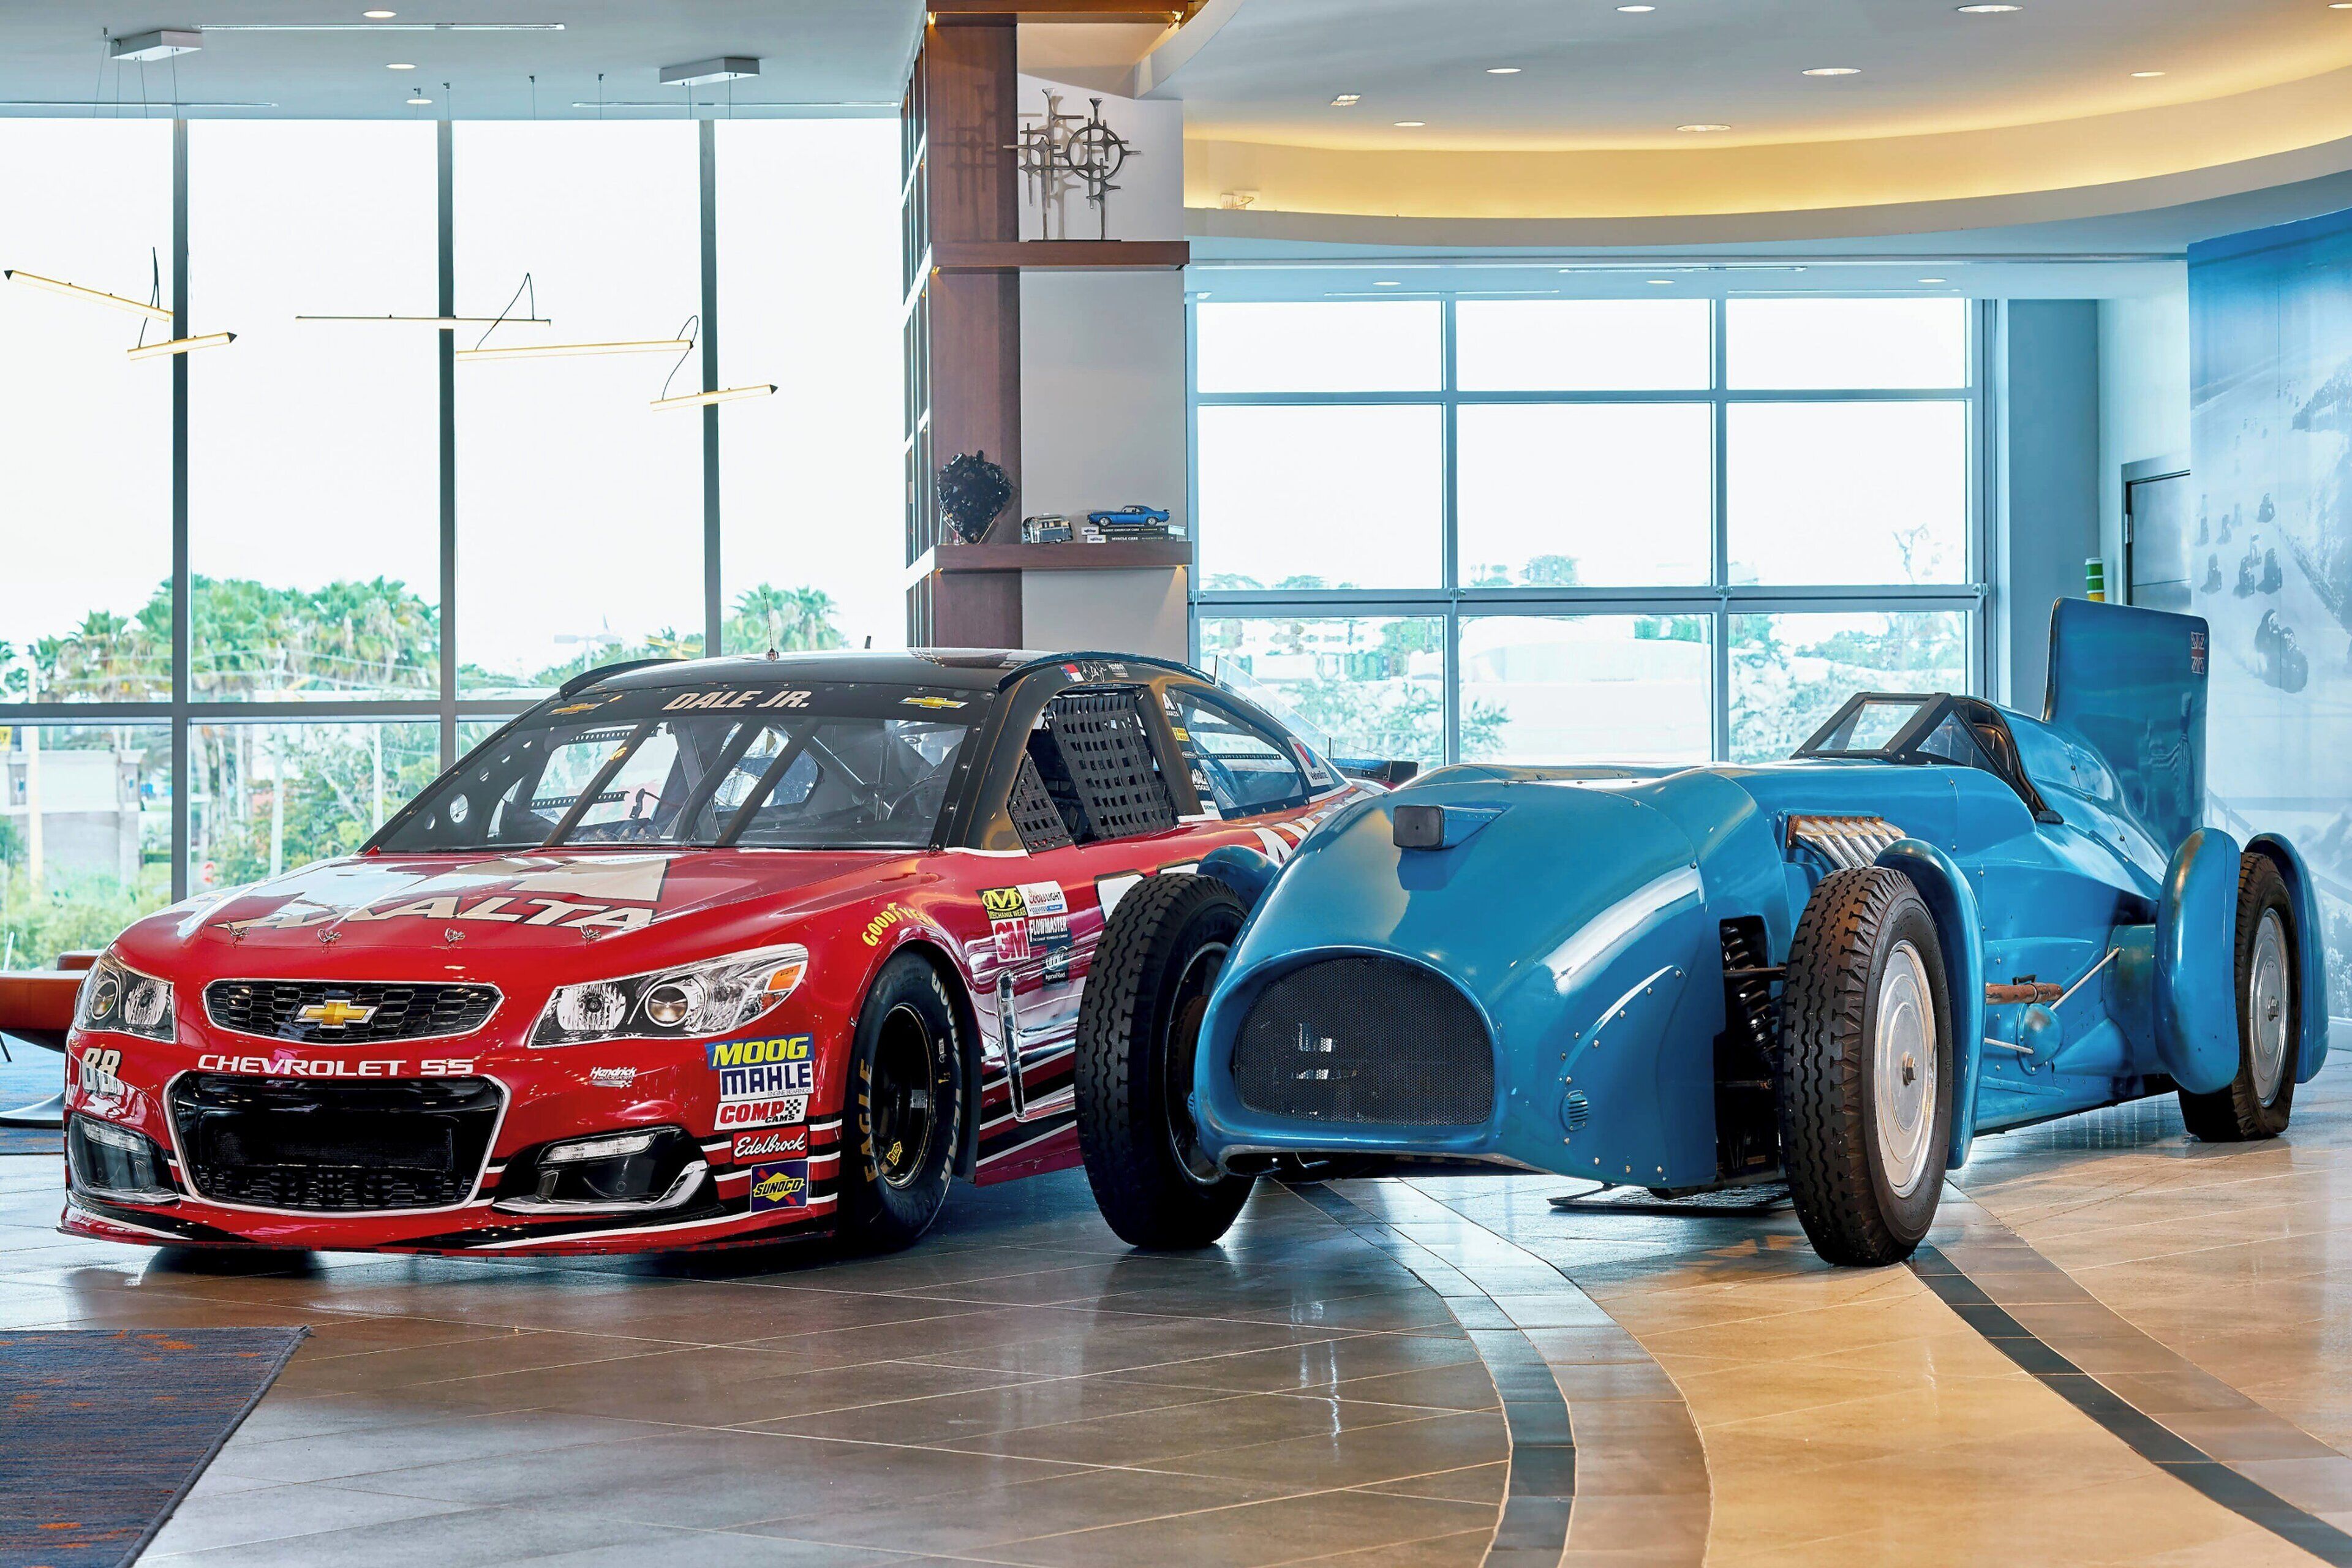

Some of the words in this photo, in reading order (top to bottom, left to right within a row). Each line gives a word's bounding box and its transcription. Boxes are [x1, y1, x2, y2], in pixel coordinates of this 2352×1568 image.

[662, 690, 763, 710] DALE
[756, 690, 812, 708] JR.
[1046, 891, 1062, 902] LIGHT
[987, 910, 1013, 919] MECHANIX
[1013, 907, 1027, 918] WEAR
[995, 919, 1028, 959] 3M
[1028, 916, 1068, 942] FLOWMASTER
[712, 1036, 809, 1066] MOOG
[81, 1047, 121, 1094] 88
[198, 1055, 407, 1076] CHEVROLET
[420, 1058, 474, 1076] SS
[589, 1066, 638, 1079] Hendrick
[721, 1063, 811, 1096] MAHLE
[720, 1100, 785, 1124] COMP
[765, 1114, 795, 1123] CAMS
[859, 1058, 880, 1182] EAGLE
[734, 1132, 806, 1158] Edelbrock
[755, 1179, 802, 1196] SUNOCO
